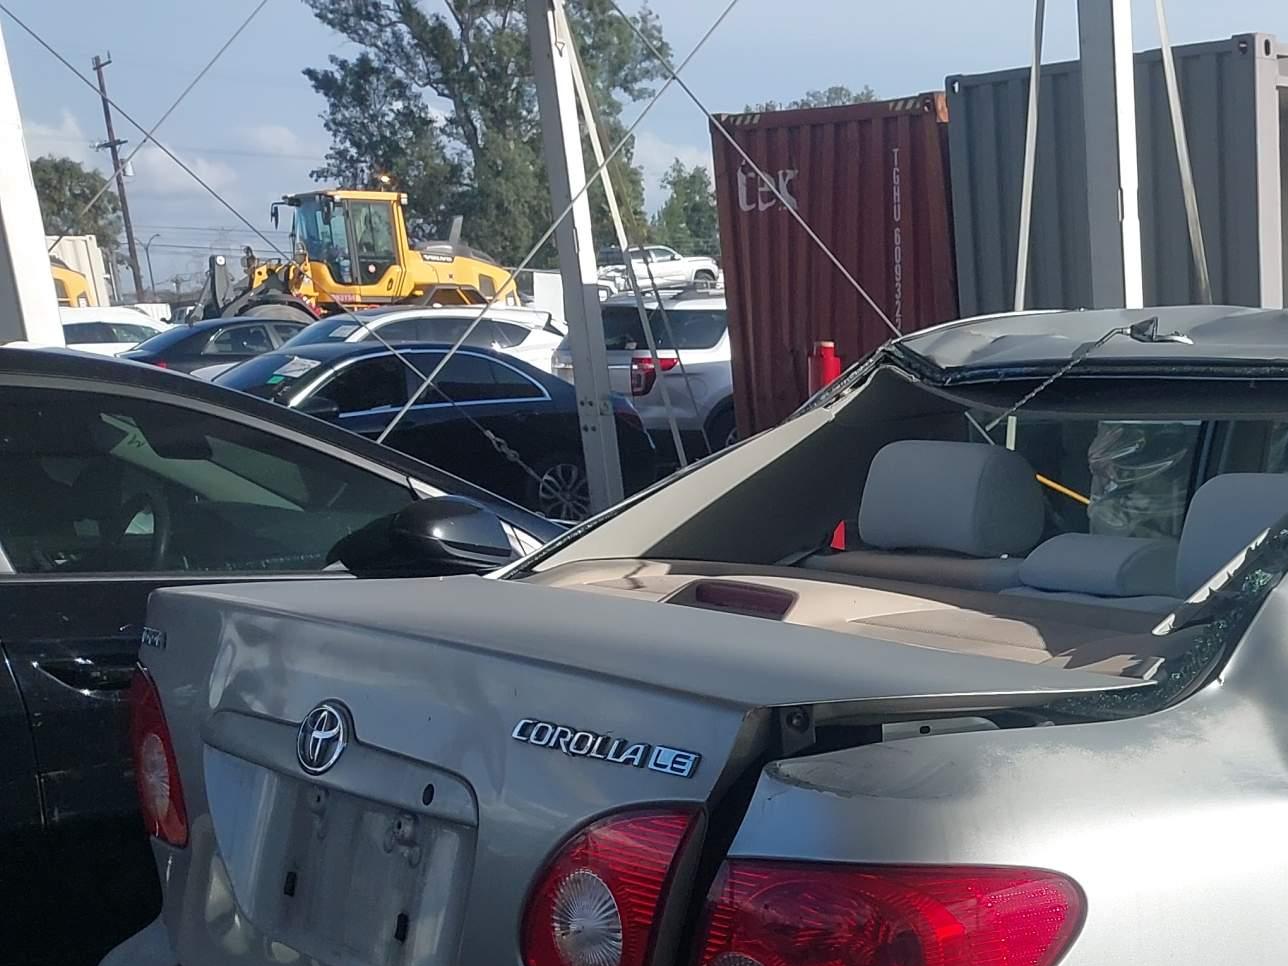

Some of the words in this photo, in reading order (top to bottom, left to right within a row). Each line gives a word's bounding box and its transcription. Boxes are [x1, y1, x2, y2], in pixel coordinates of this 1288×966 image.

[892, 148, 901, 222] TGHU
[511, 718, 646, 767] COROLLA
[651, 747, 694, 776] LE
